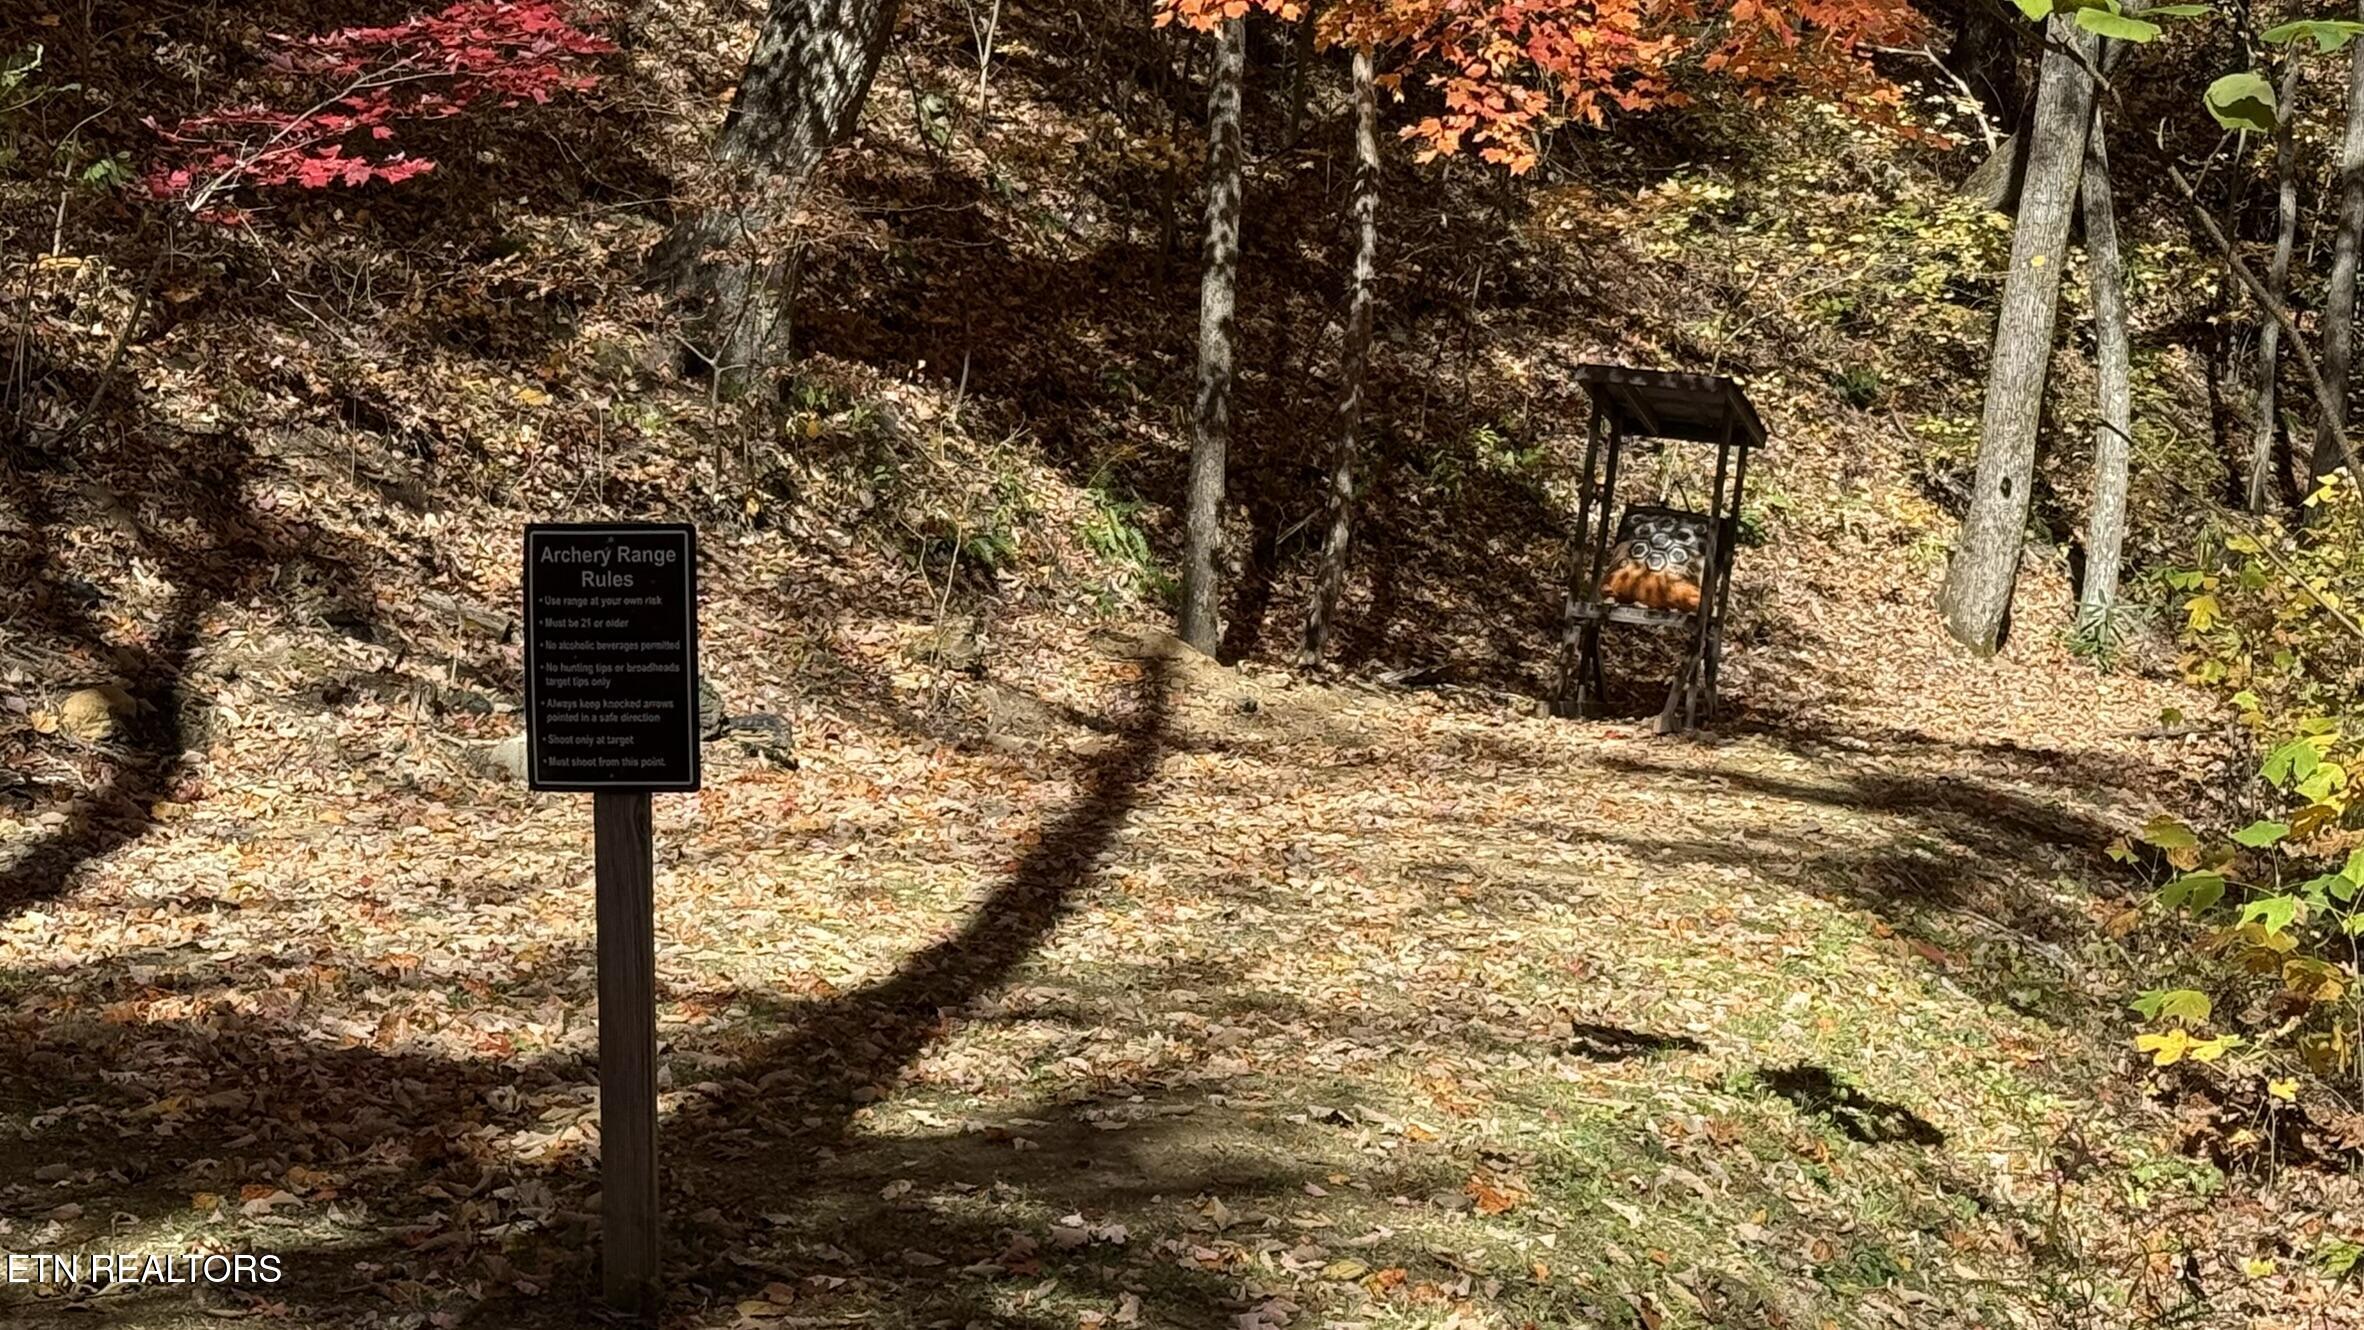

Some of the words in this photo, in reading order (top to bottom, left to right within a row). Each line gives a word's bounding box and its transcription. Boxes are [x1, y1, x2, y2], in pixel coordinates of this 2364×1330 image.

[541, 546, 612, 567] Archery
[618, 546, 676, 566] Range
[582, 570, 634, 587] Rules
[545, 596, 561, 605] Use
[563, 598, 587, 607] range
[590, 597, 599, 605] at
[601, 598, 621, 607] your
[645, 596, 663, 605] risk
[545, 618, 566, 627] Must
[568, 619, 579, 627] be
[581, 618, 591, 627] 21
[606, 618, 629, 627] older
[546, 640, 557, 649] No
[559, 641, 595, 650] alcoholic
[596, 642, 639, 652] beverages
[641, 640, 680, 651] permitted
[546, 662, 558, 672] No
[561, 663, 594, 674] hunting
[596, 664, 612, 674] tips
[627, 663, 680, 672] broadheads
[546, 677, 571, 688] target
[573, 677, 589, 687] tips
[592, 677, 611, 688] only
[546, 699, 577, 710] Always
[580, 699, 600, 710] keep
[603, 699, 641, 708] knocked
[546, 713, 579, 723] pointed
[581, 713, 590, 721] in
[599, 712, 618, 722] safe
[621, 713, 661, 722] direction
[548, 734, 573, 744] Shoot
[575, 735, 594, 746] only
[596, 736, 605, 744] at
[607, 736, 634, 746] target
[548, 757, 570, 766] Must
[572, 757, 597, 766] shoot
[599, 757, 619, 766] from
[622, 758, 638, 766] this
